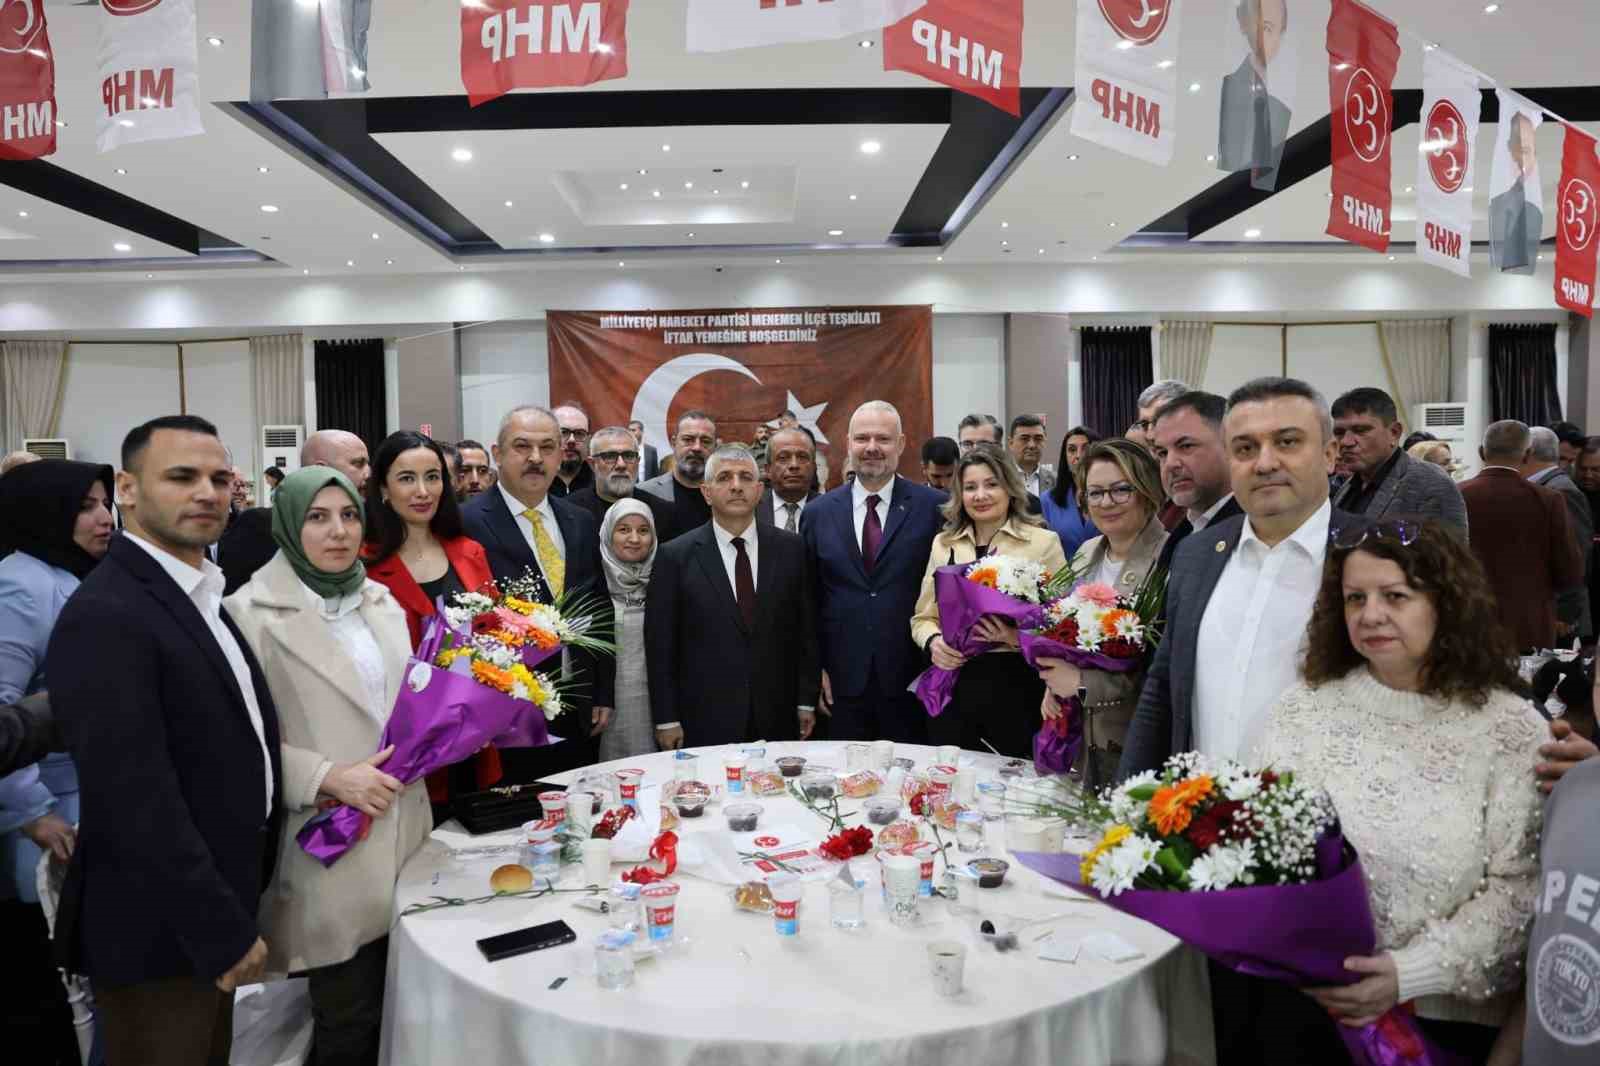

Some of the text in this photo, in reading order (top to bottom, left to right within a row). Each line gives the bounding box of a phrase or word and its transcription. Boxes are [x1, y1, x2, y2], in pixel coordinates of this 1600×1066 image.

[659, 315, 705, 328] HAREKET
[707, 312, 749, 327] PARTİSİ
[751, 313, 802, 326] MENEMEN
[804, 311, 827, 328] İLÇE
[829, 311, 880, 326] TEŞKİLATI
[663, 328, 817, 344] İFTAR YEMEĞİNE HOŞGELDİNİZ
[1535, 870, 1600, 935] PE
[1553, 957, 1591, 991] TOKYO
